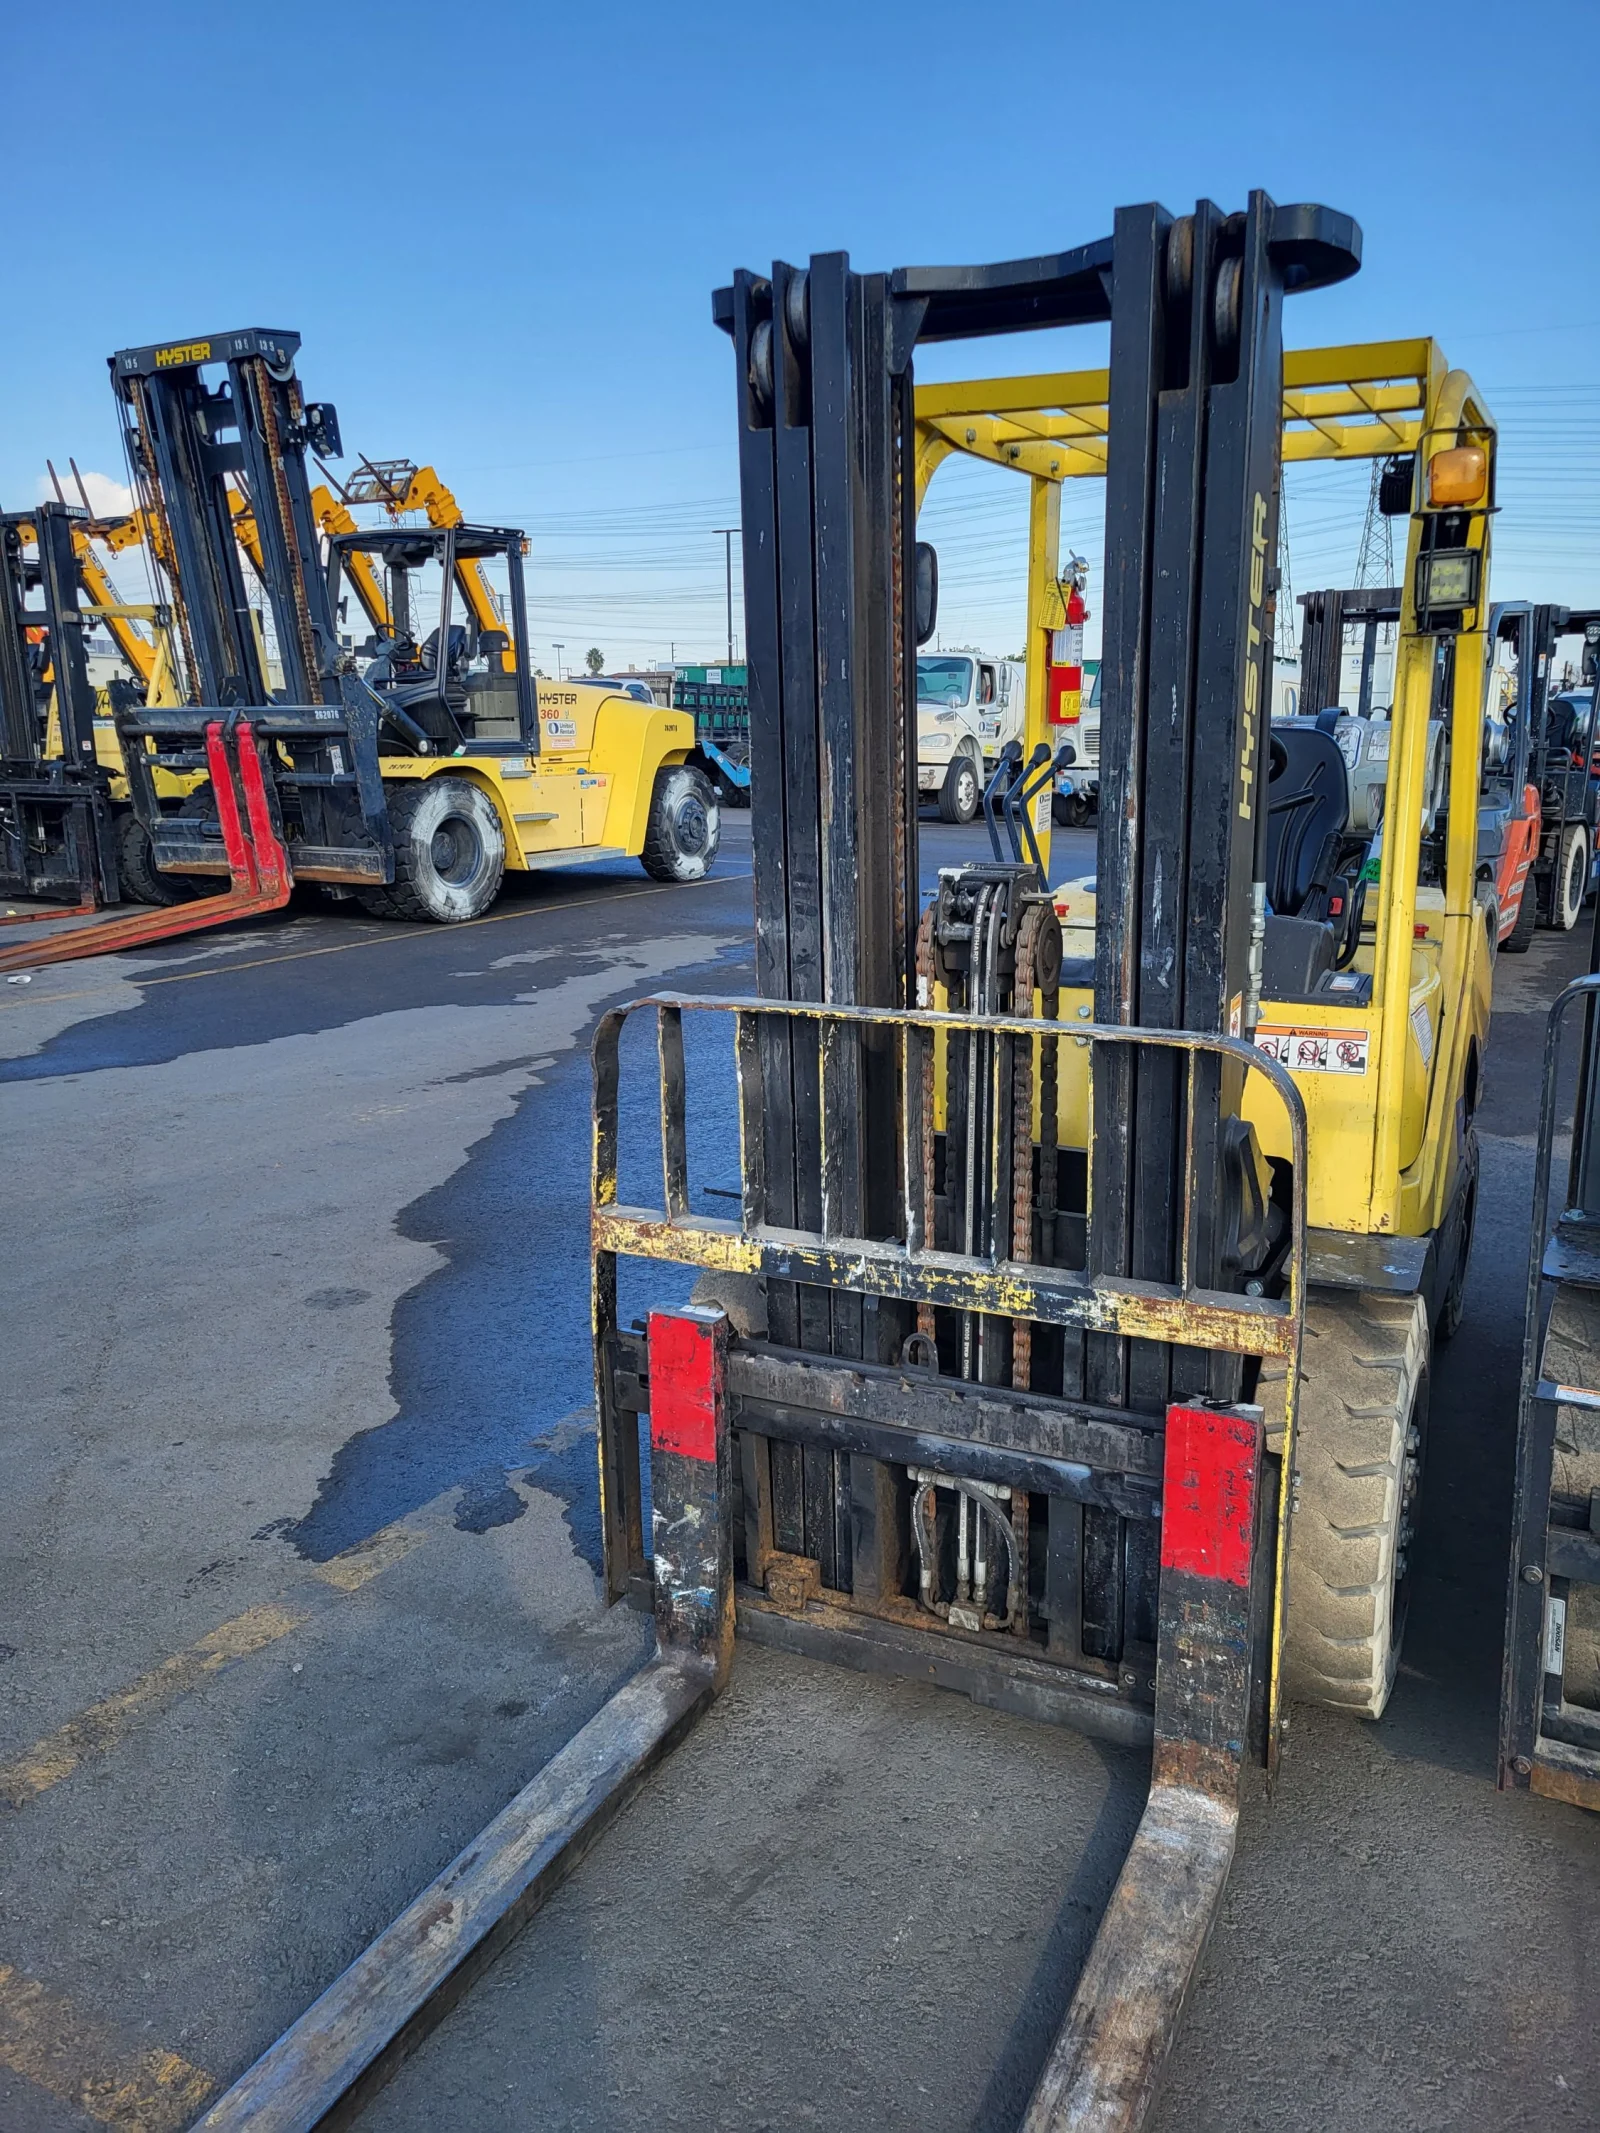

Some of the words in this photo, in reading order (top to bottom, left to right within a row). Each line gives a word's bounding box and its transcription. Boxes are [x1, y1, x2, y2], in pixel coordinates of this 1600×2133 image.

[155, 342, 211, 368] HYSTER
[1238, 491, 1268, 820] HYSTER
[539, 693, 577, 705] HYSTER
[314, 710, 340, 719] 262076
[540, 709, 560, 719] 360
[972, 926, 981, 963] DIEHARD
[1554, 1622, 1562, 1652] DOOSAN
